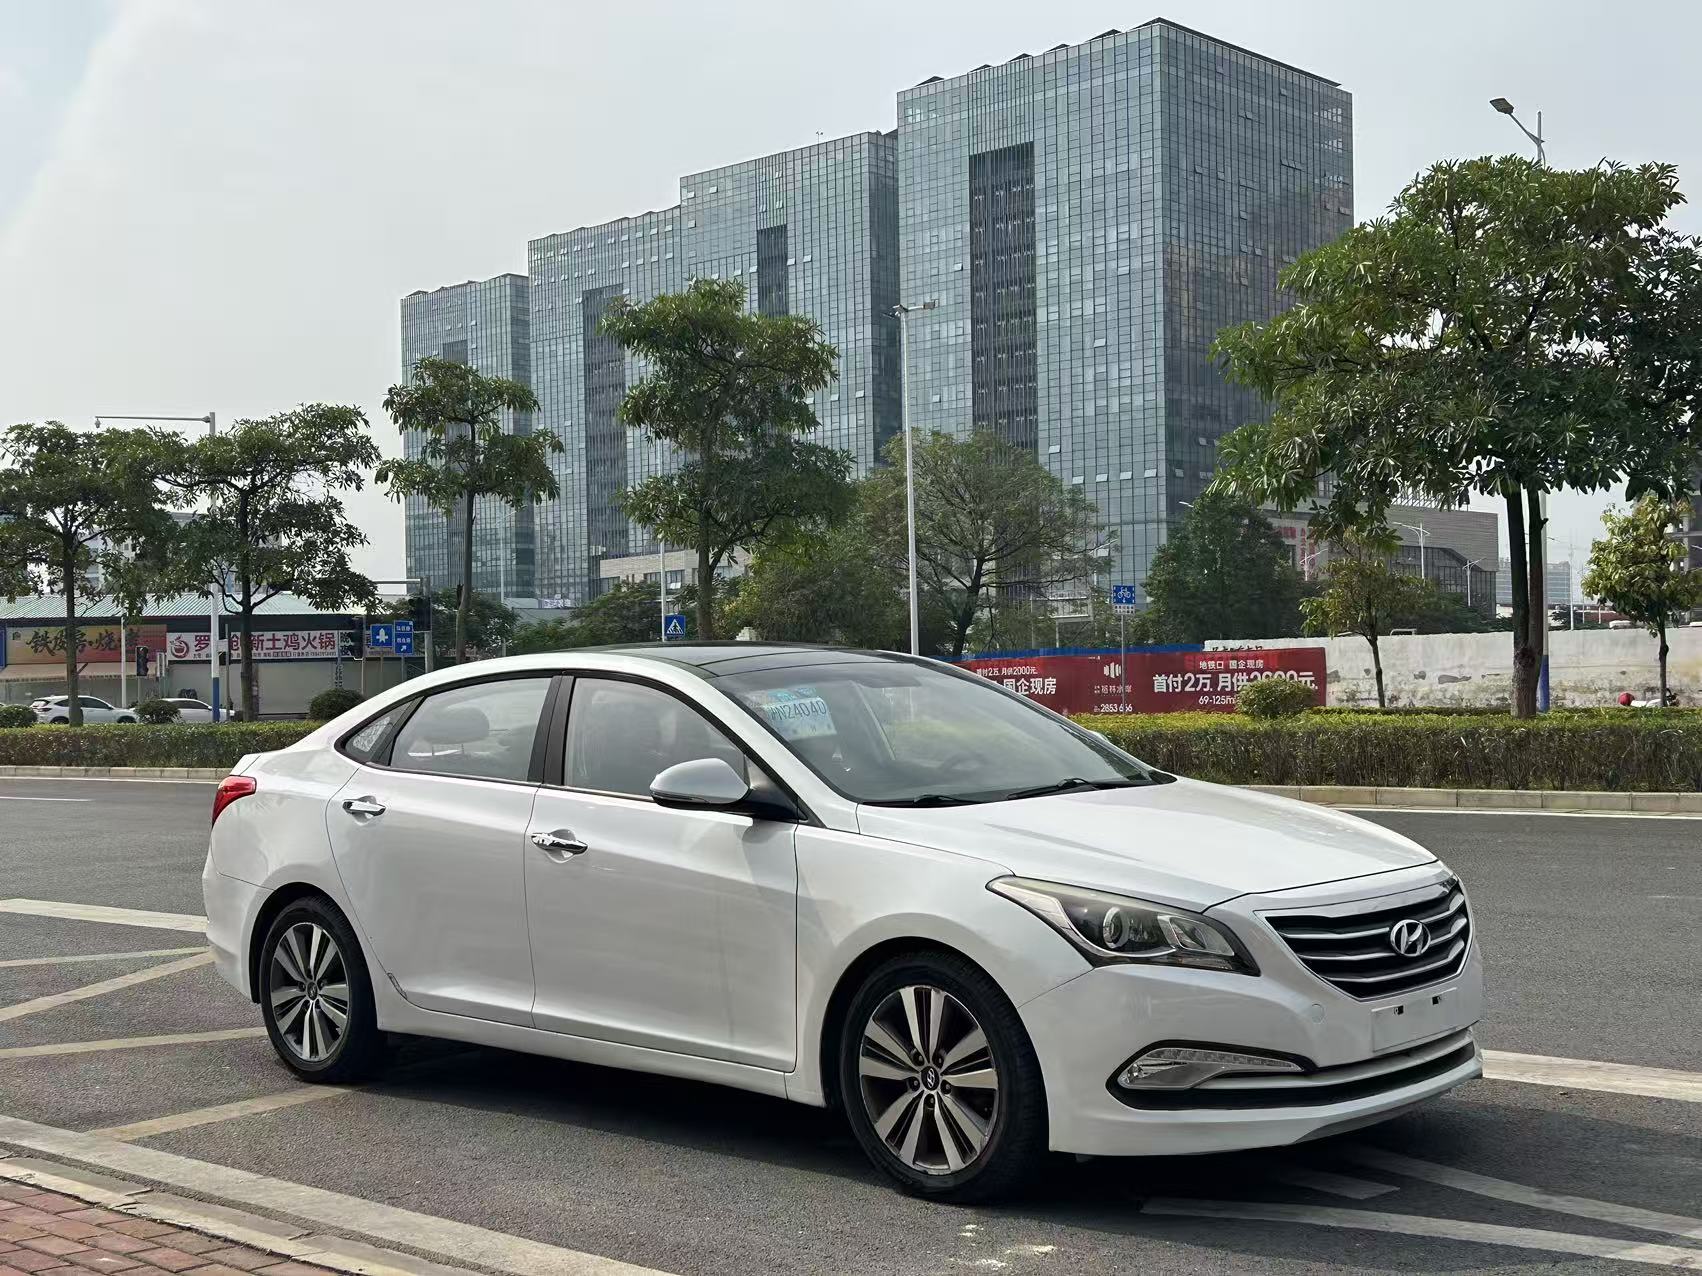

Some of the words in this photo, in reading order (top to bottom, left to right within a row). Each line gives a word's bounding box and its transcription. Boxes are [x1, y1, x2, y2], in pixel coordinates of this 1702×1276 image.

[194, 632, 336, 652] 罗创新土鸡火锅
[1199, 660, 1224, 670] 地铁口
[1229, 659, 1264, 669] 国企现房
